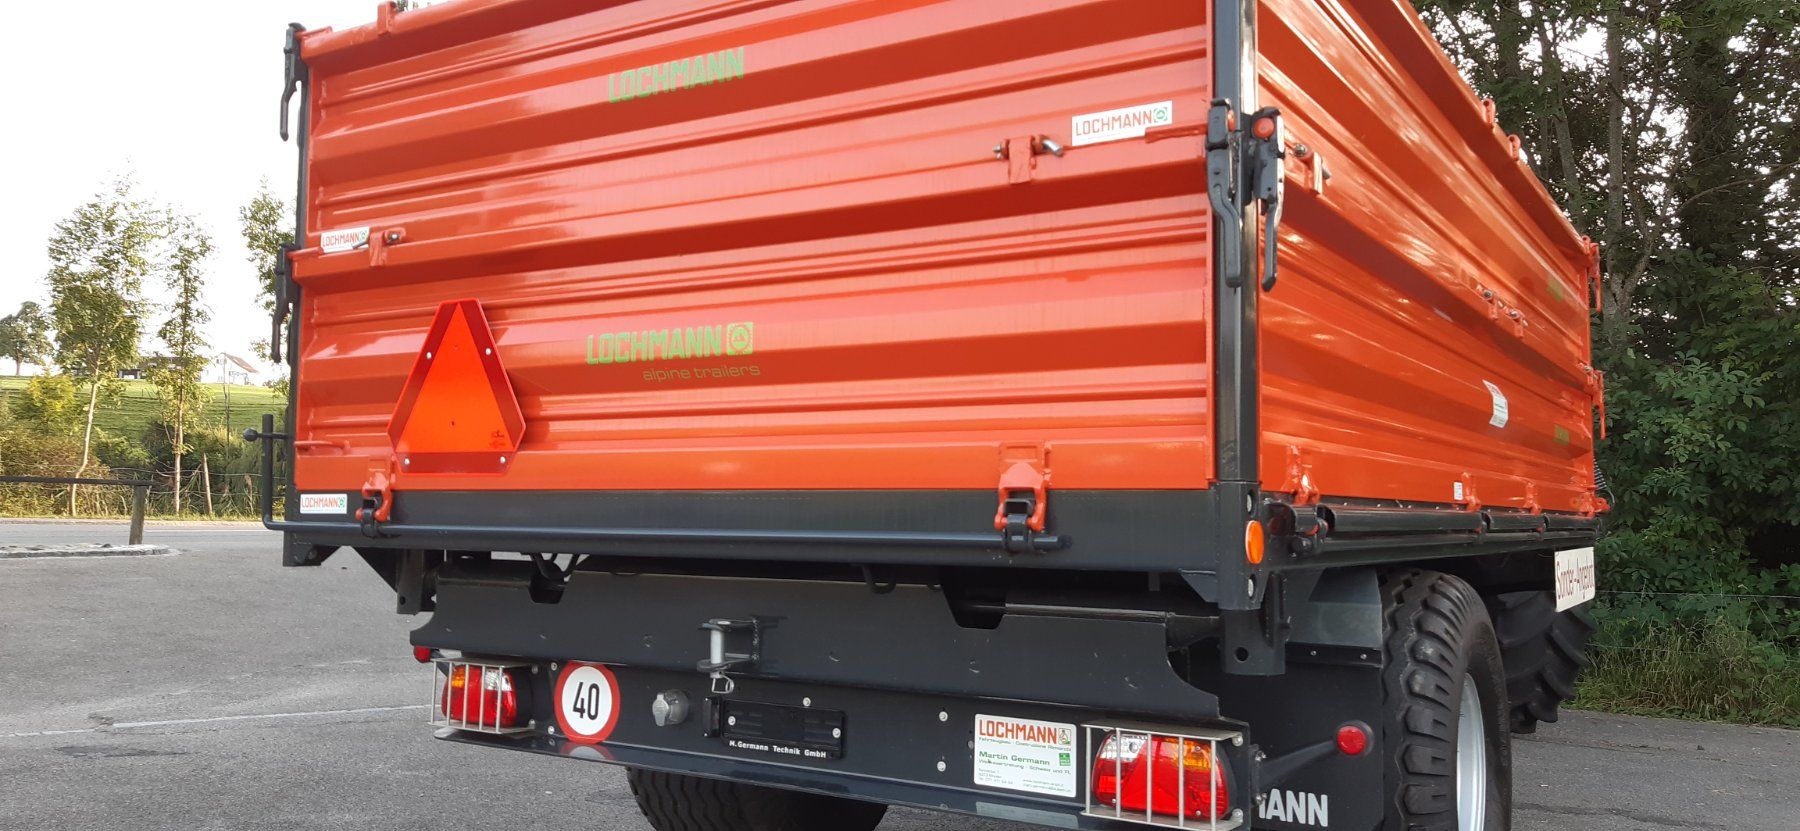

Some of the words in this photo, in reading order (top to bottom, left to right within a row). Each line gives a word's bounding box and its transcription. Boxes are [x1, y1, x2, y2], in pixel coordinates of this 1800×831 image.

[608, 47, 744, 103] LOCHMANN
[1075, 109, 1152, 136] LOCHMANN
[322, 231, 360, 247] LOCHMANN
[587, 325, 722, 364] LOCHMANN
[643, 366, 691, 382] alpine
[694, 364, 760, 379] trailers
[301, 496, 338, 508] LOCHMANN
[573, 681, 600, 720] 40
[979, 719, 1057, 744] LOCHMANN
[773, 745, 801, 755] Technik
[804, 749, 827, 758] GmbH
[979, 751, 1009, 761] Martin
[1011, 755, 1050, 765] Germann
